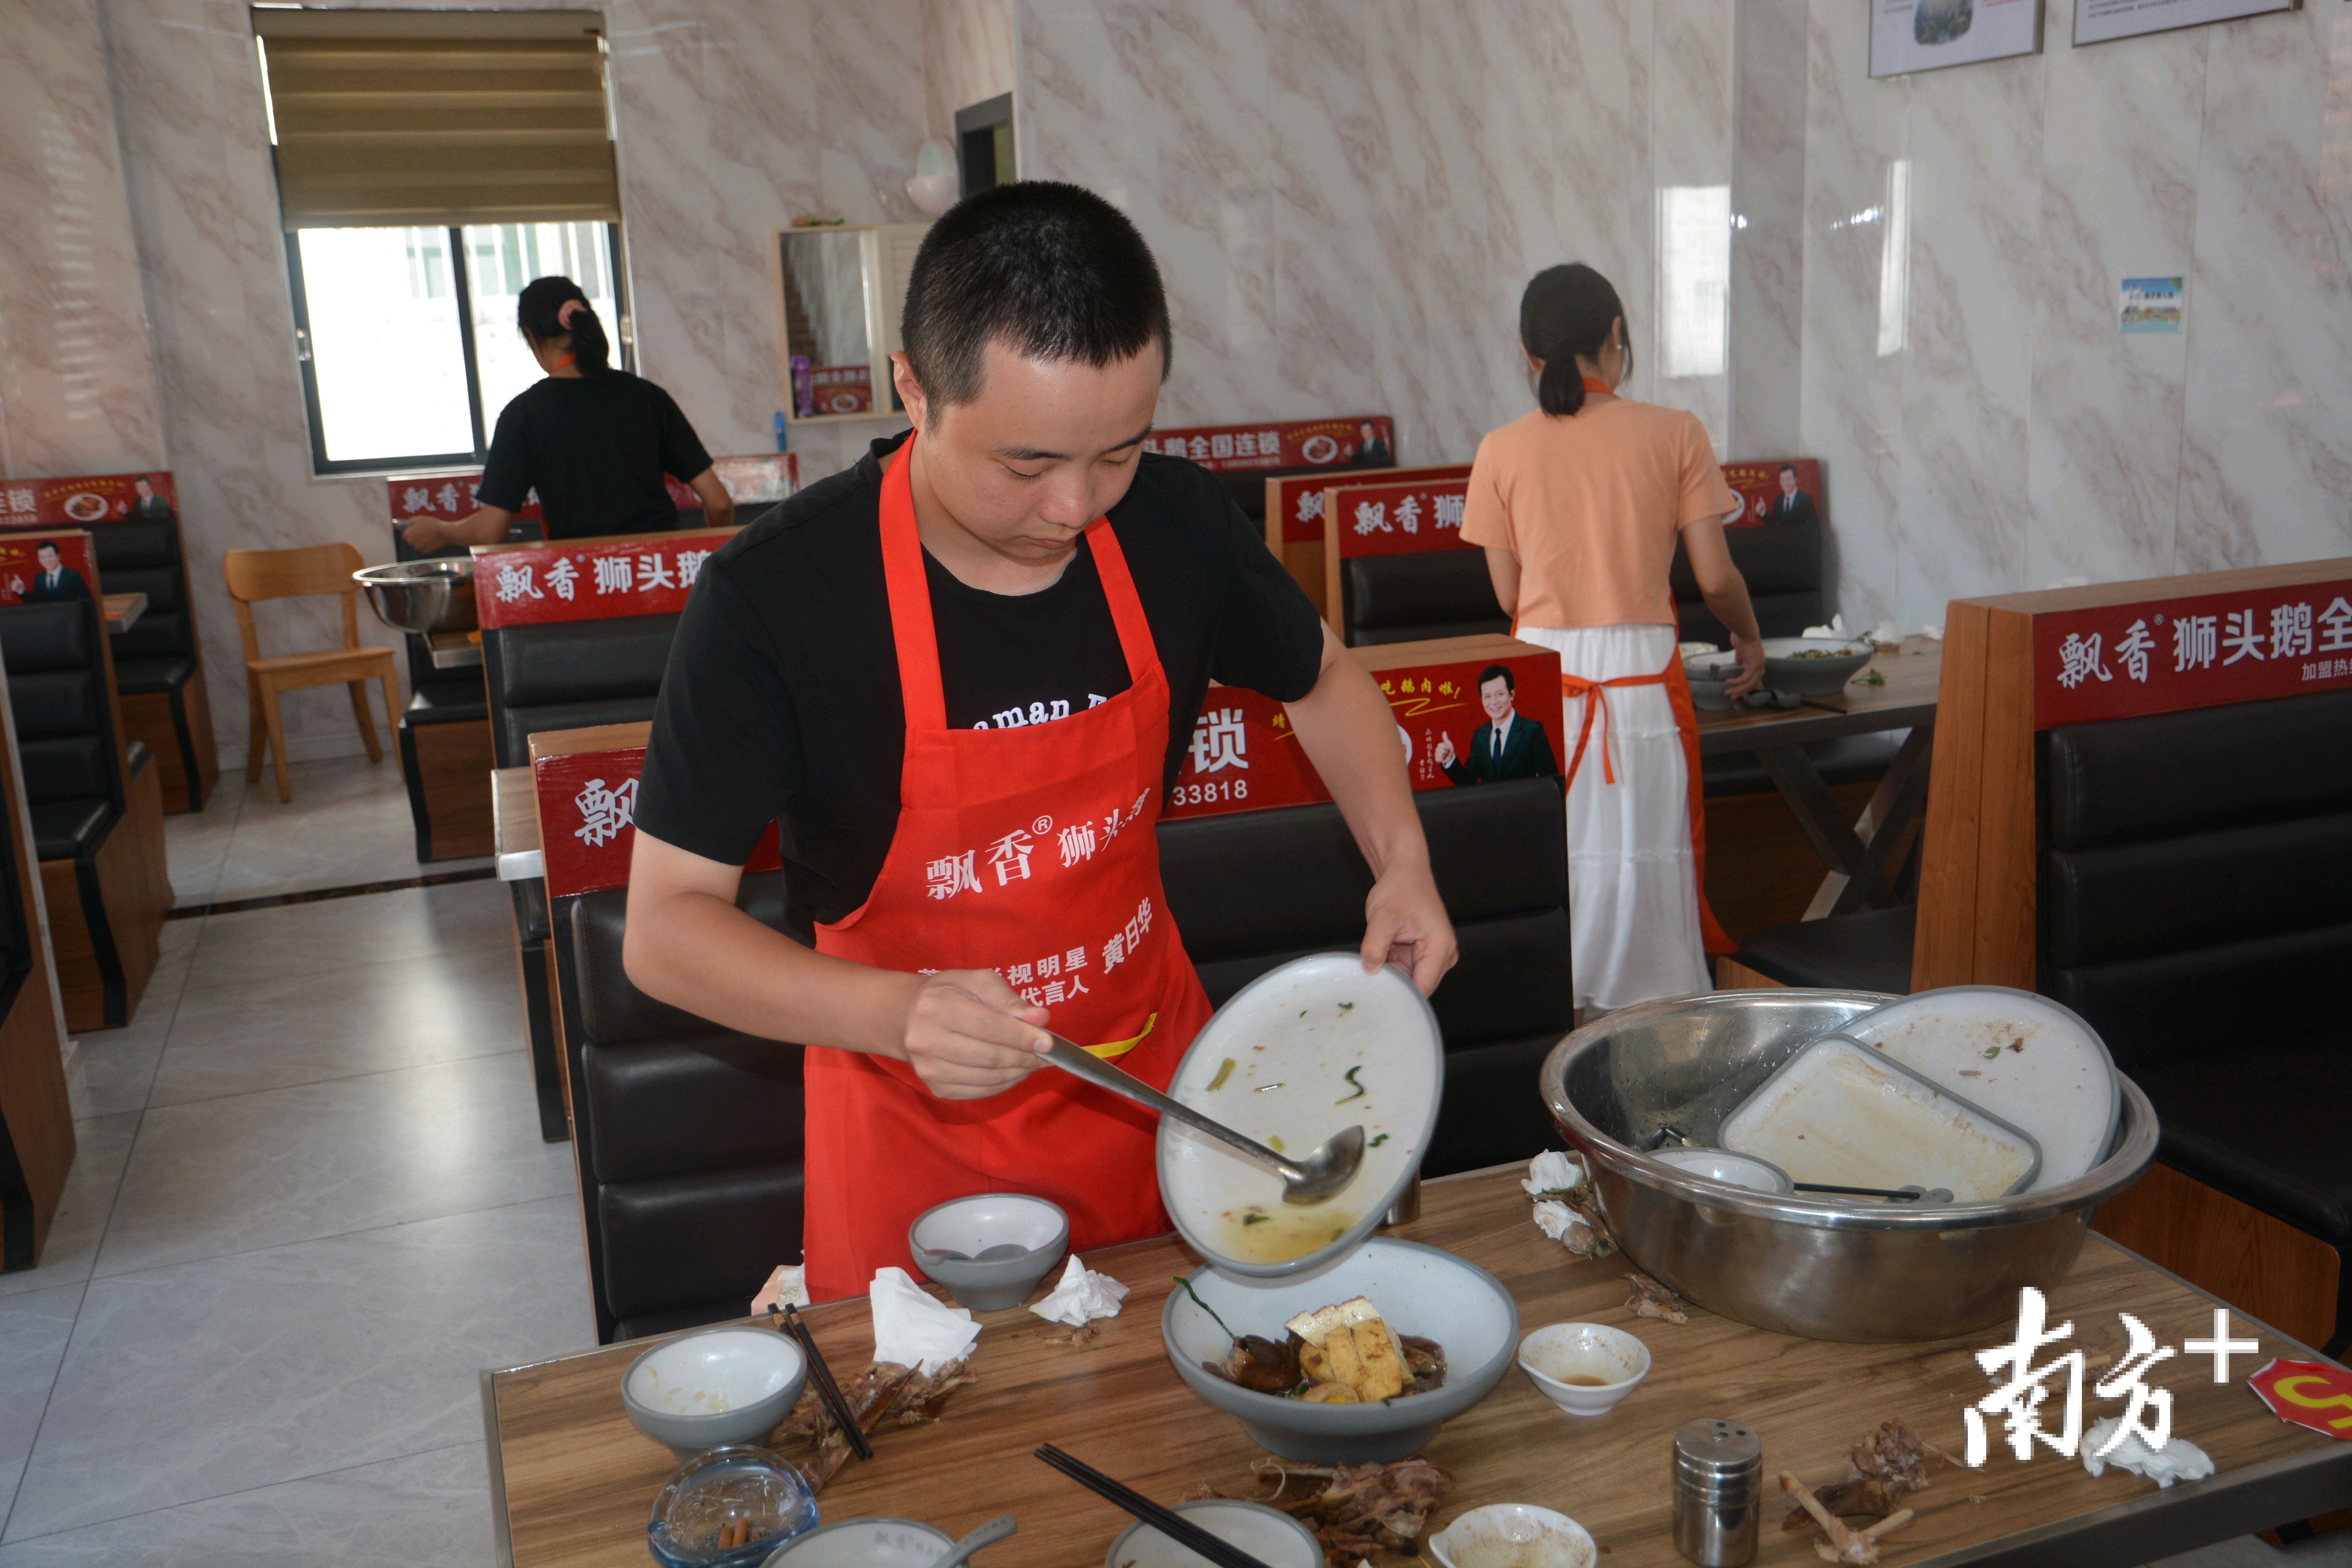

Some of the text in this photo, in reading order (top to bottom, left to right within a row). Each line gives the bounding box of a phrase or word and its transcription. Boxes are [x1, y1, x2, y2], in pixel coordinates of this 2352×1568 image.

[1188, 708, 1249, 774] 锁
[575, 779, 639, 848] 飘
[1173, 779, 1248, 806] 33818
[1102, 897, 1152, 974] 黄日华
[1020, 975, 1089, 1007] 代言人
